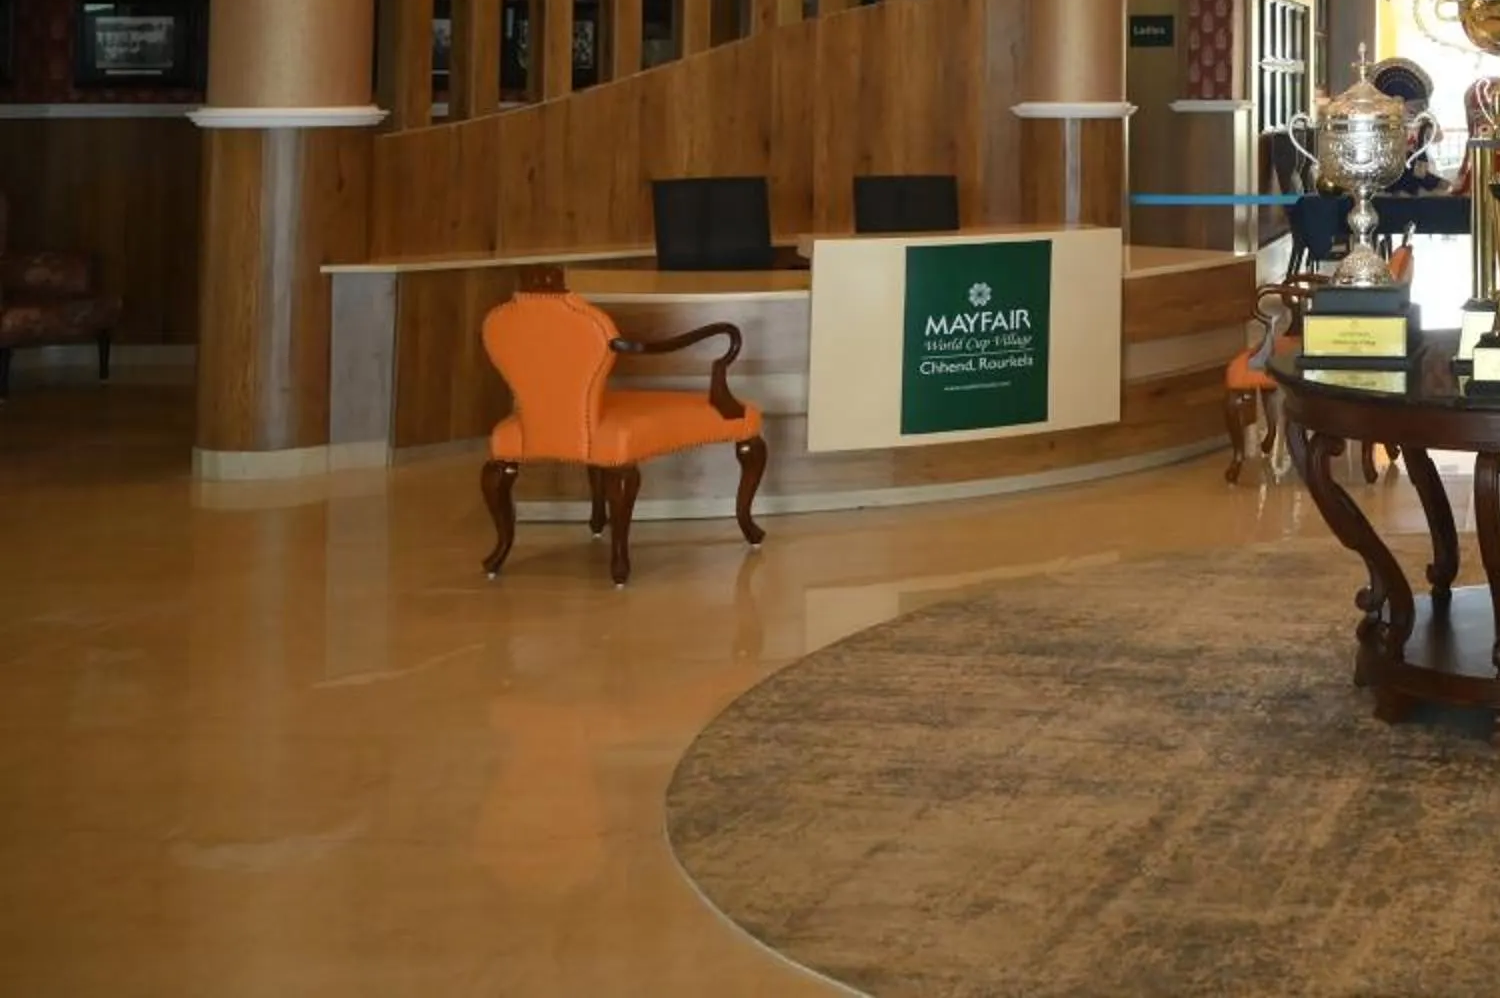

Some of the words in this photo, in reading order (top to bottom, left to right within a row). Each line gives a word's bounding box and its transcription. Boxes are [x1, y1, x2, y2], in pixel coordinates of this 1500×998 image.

[924, 309, 1031, 336] MAYFAIR
[923, 337, 963, 351] World
[965, 337, 991, 353] Cup
[992, 334, 1033, 349] Village
[979, 354, 1033, 370] Rourkela
